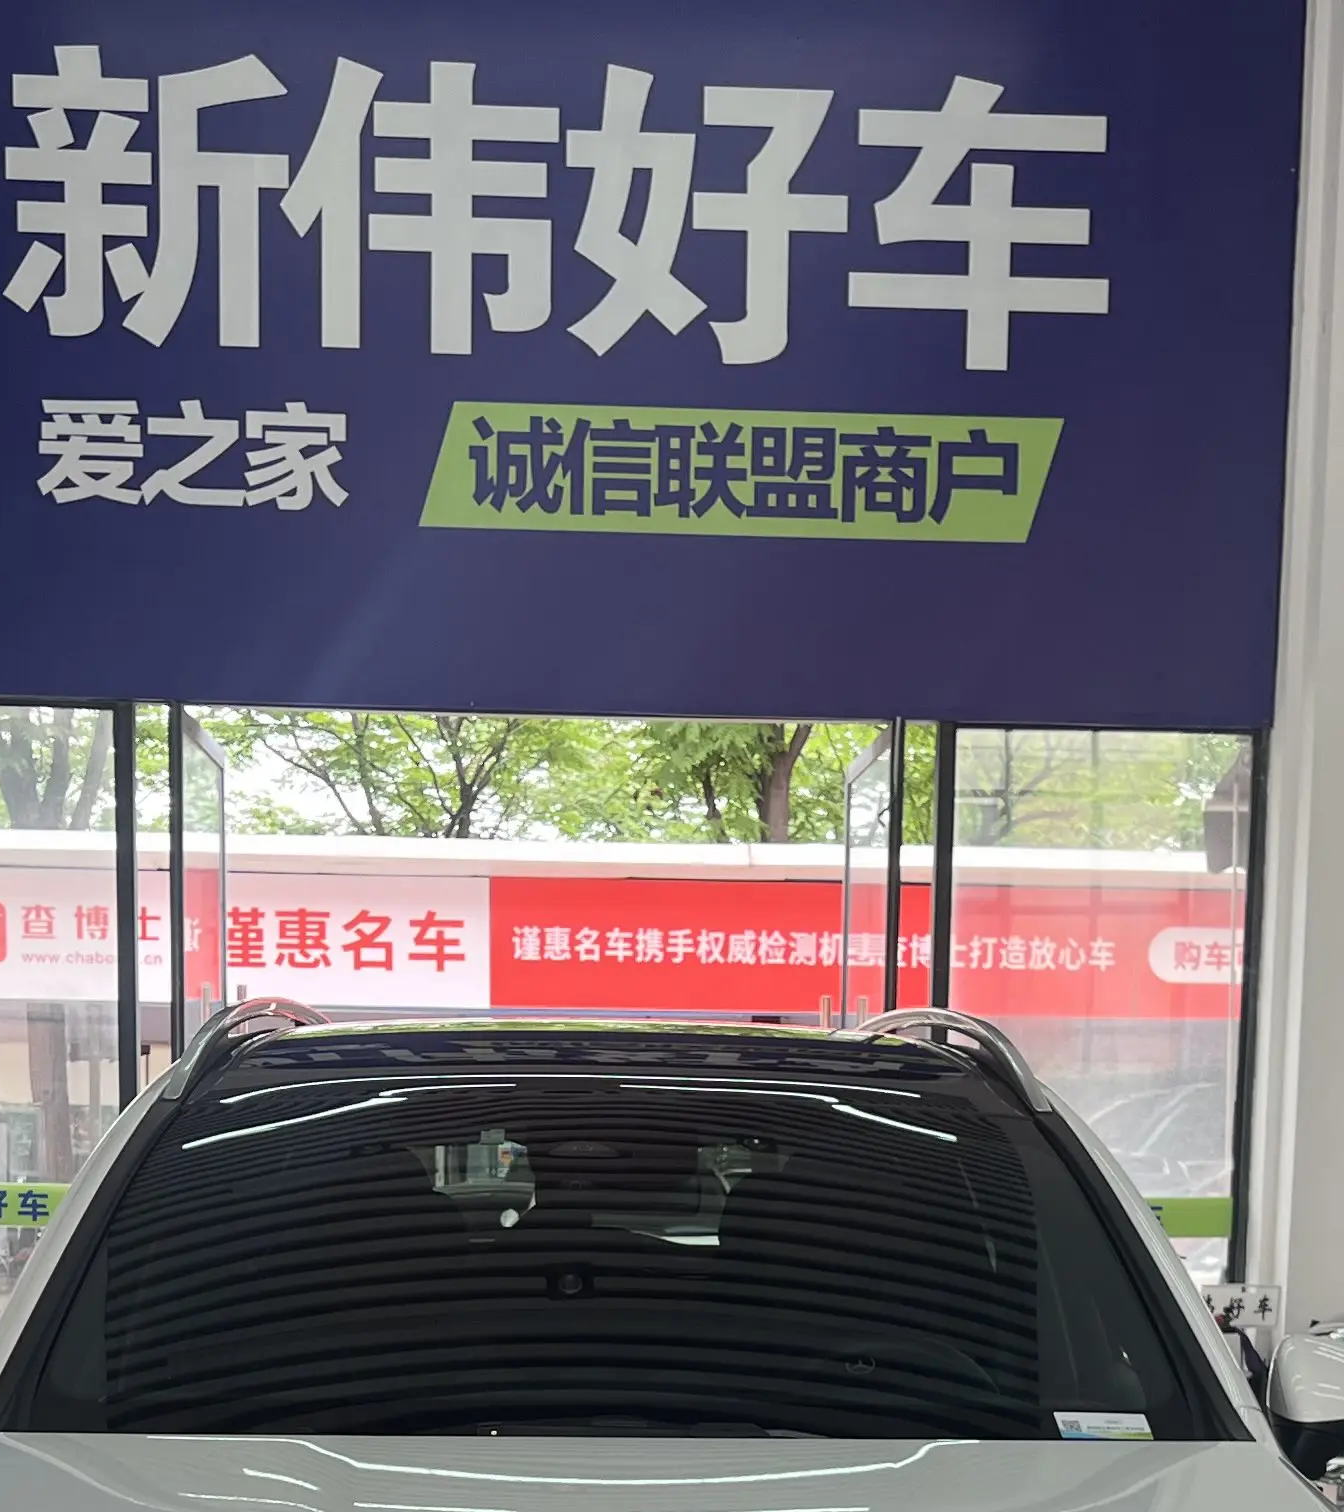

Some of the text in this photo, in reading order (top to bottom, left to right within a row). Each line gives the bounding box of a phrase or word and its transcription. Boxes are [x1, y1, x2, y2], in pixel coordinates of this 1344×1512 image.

[3, 44, 1109, 371] 新伟好车
[38, 400, 348, 510] 爱之家
[468, 415, 1019, 525] 诚信联盟商户
[21, 904, 161, 941] 查博士
